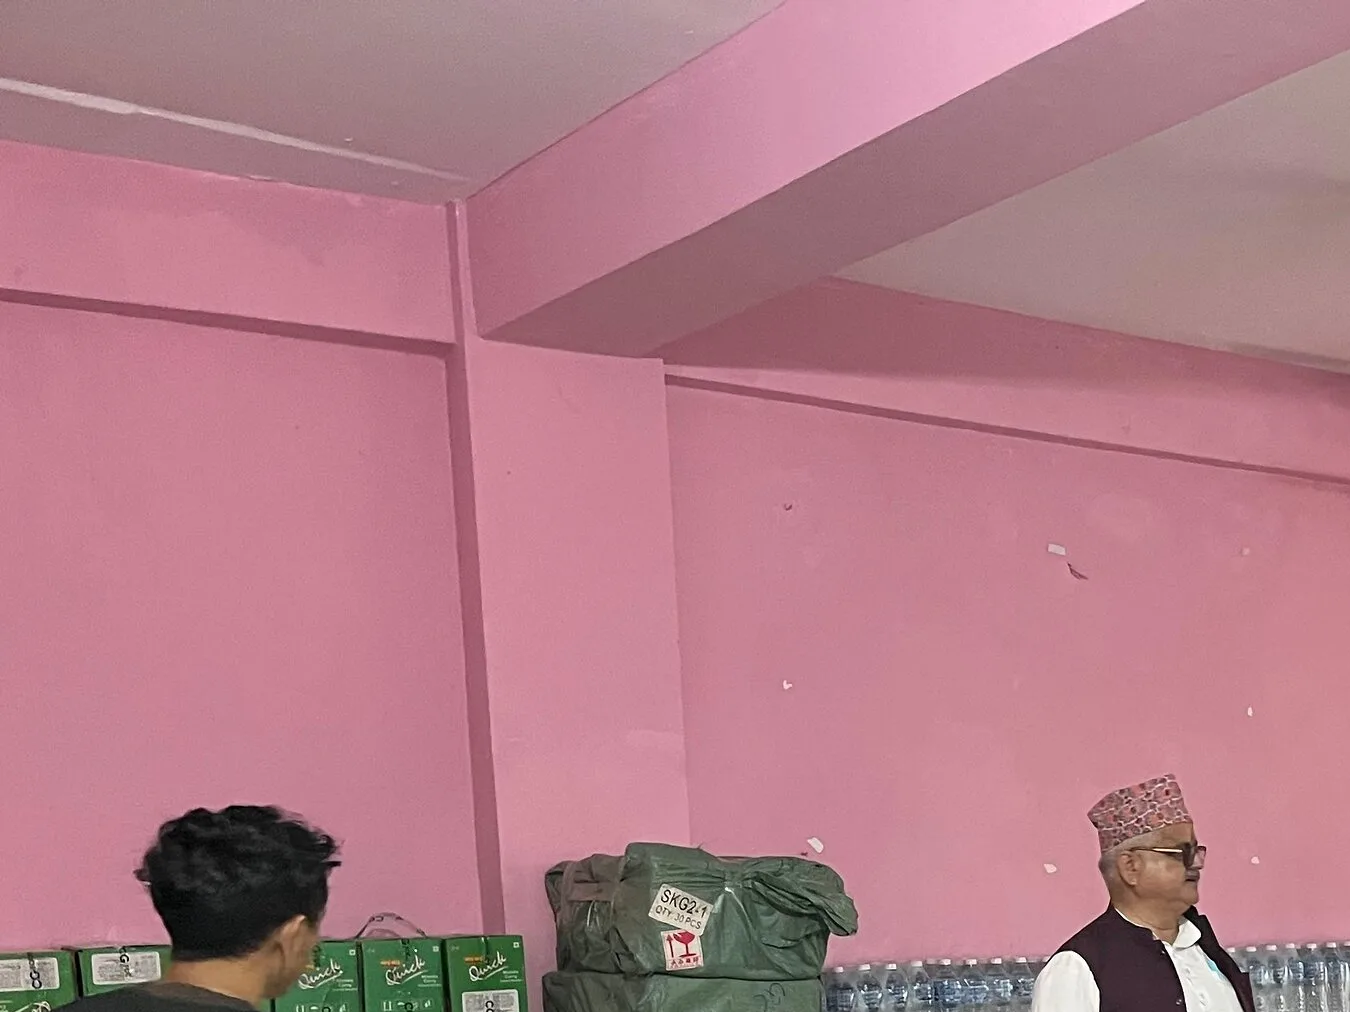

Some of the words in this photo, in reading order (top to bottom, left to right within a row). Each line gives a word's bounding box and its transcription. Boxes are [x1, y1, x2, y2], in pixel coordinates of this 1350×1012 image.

[655, 905, 673, 917] QTY
[685, 917, 702, 930] PCS
[661, 889, 707, 918] SKG2-1
[385, 955, 426, 986] Quick
[469, 951, 507, 982] Quick
